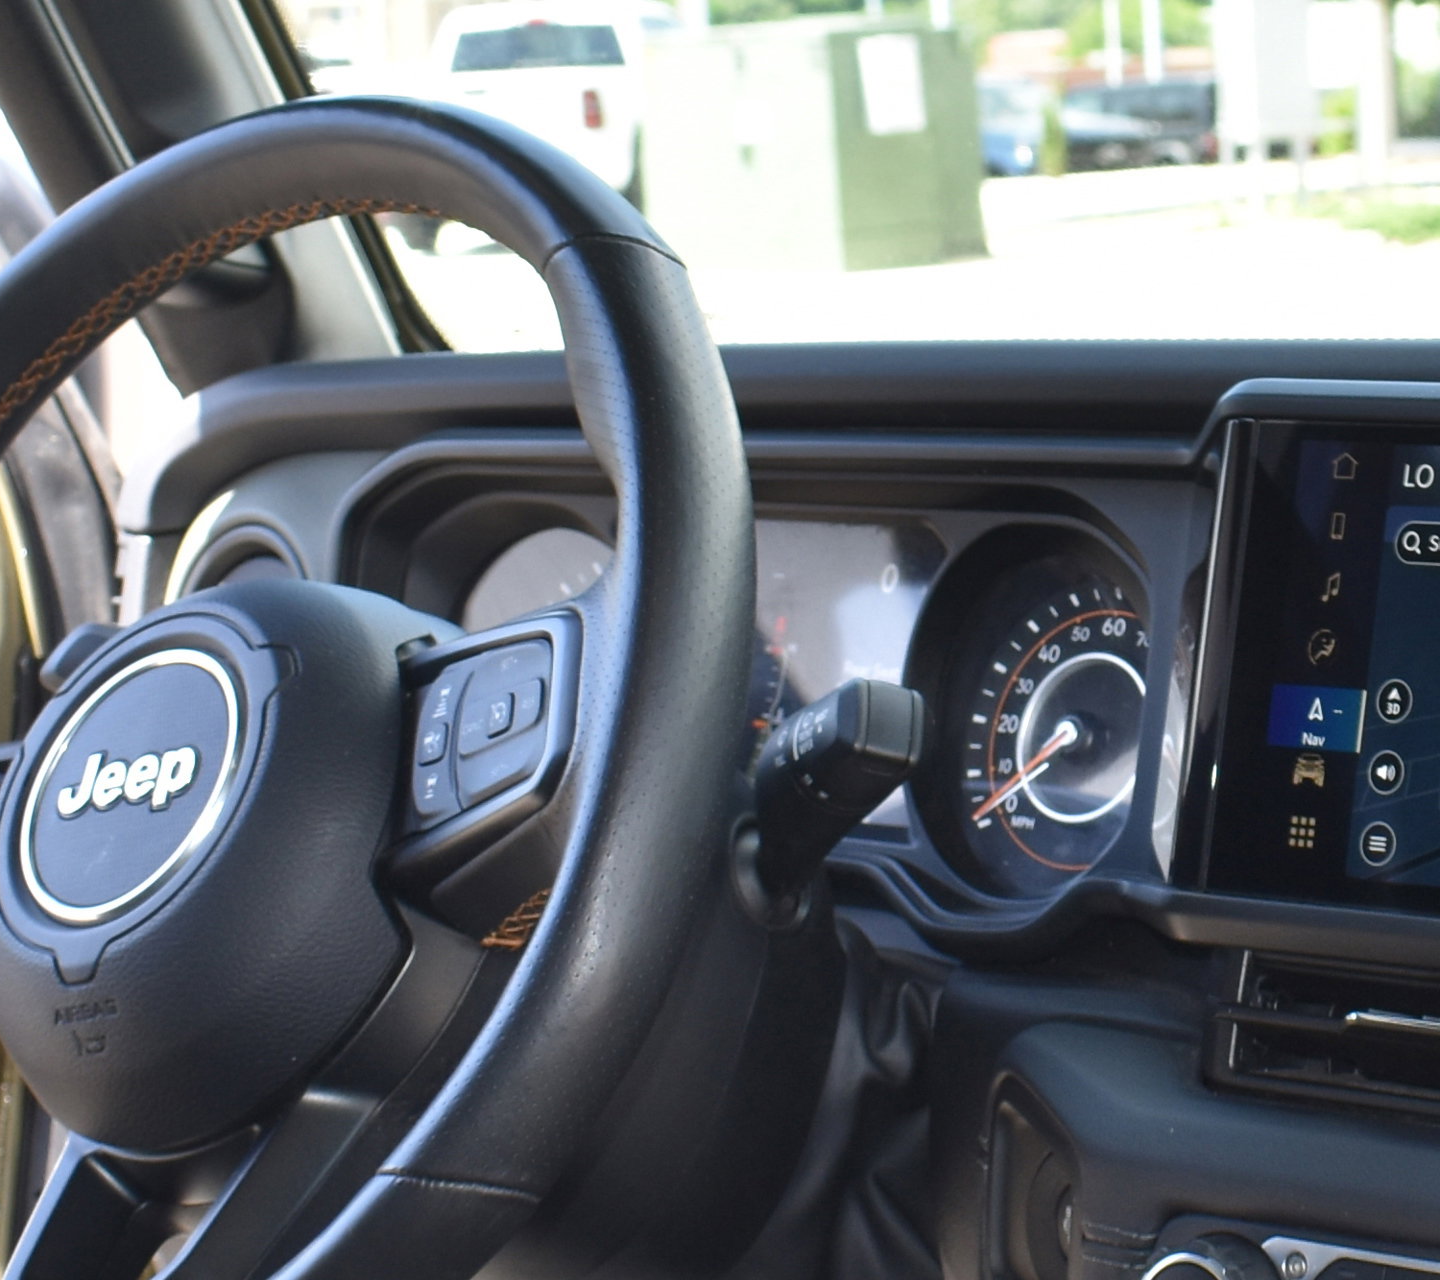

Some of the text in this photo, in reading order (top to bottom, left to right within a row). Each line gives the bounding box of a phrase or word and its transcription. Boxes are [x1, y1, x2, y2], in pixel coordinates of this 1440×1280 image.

[1402, 464, 1435, 489] LO
[1071, 627, 1090, 642] 50
[1102, 618, 1127, 636] 60
[1038, 645, 1060, 663] 40
[1015, 678, 1034, 694] 30
[1386, 703, 1400, 715] 3D
[998, 714, 1018, 733] 20
[1302, 732, 1326, 747] Nav
[998, 759, 1013, 775] 10
[56, 743, 198, 816] Jeep
[1005, 797, 1018, 813] 0
[1010, 817, 1036, 830] MPH
